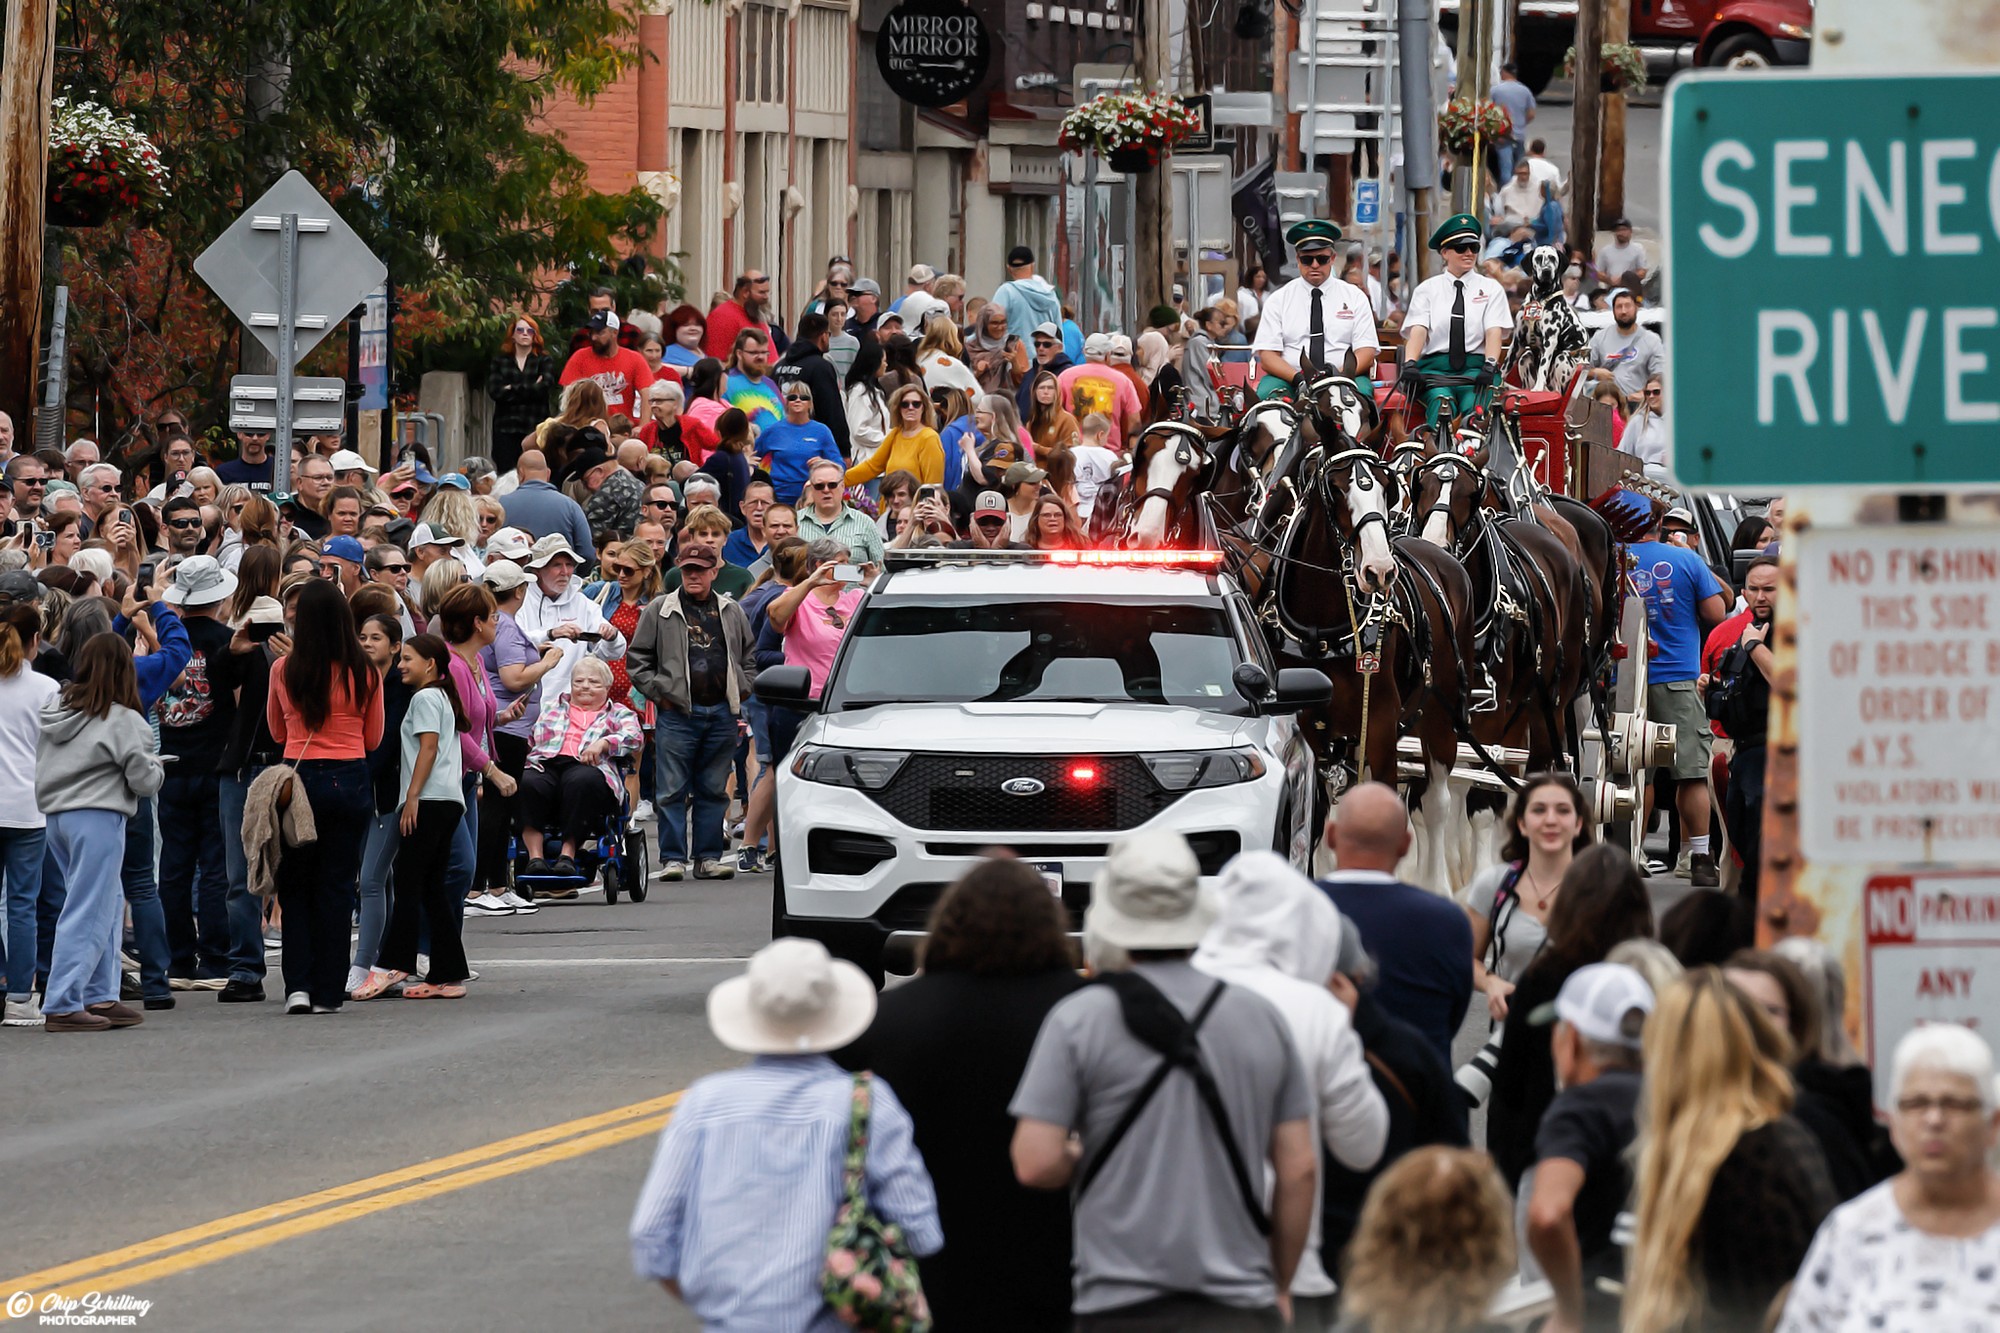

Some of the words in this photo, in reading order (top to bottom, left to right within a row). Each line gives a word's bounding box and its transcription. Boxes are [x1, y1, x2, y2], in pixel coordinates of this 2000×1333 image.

[889, 15, 978, 36] MIRROR
[888, 36, 978, 57] MIRROR
[1698, 138, 2000, 258] SENE
[1242, 214, 1272, 261] OPEN
[1828, 548, 1874, 586] NO
[1861, 595, 1918, 632] THIS
[1930, 594, 1990, 632] SIDE
[1829, 640, 1862, 679] OF
[1875, 639, 1970, 678] BRIDGE
[1858, 686, 1950, 724] ORDER
[1958, 685, 1990, 722] OF
[1012, 780, 1035, 792] Ford
[1835, 778, 1959, 806] VIOLATORS
[1834, 815, 1862, 842] BE
[1870, 886, 1914, 937] NO
[1916, 968, 1975, 998] ANY
